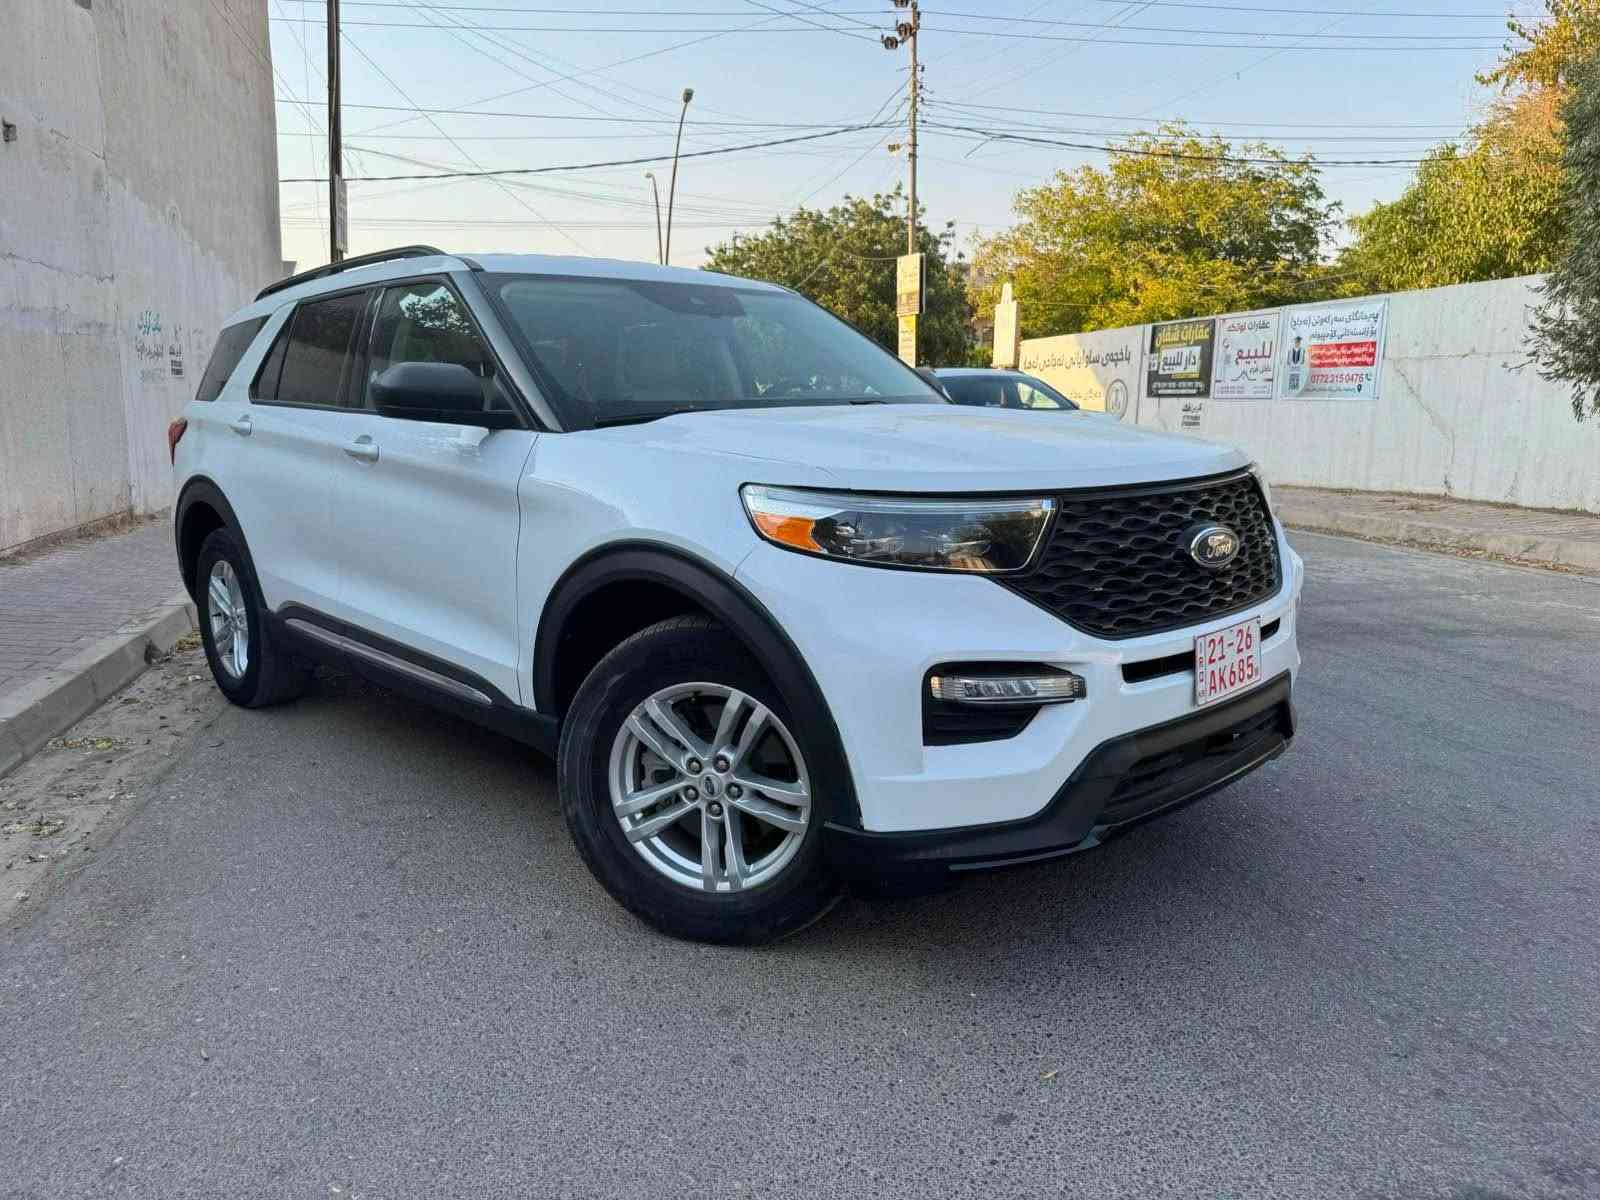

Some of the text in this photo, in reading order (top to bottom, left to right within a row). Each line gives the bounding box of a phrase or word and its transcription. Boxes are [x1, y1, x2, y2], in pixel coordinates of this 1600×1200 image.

[1162, 350, 1197, 372] دار للبيع
[1235, 340, 1273, 365] للبيع
[1206, 535, 1233, 559] Ford
[1208, 625, 1253, 665] 21-26
[1208, 654, 1255, 696] AK685
